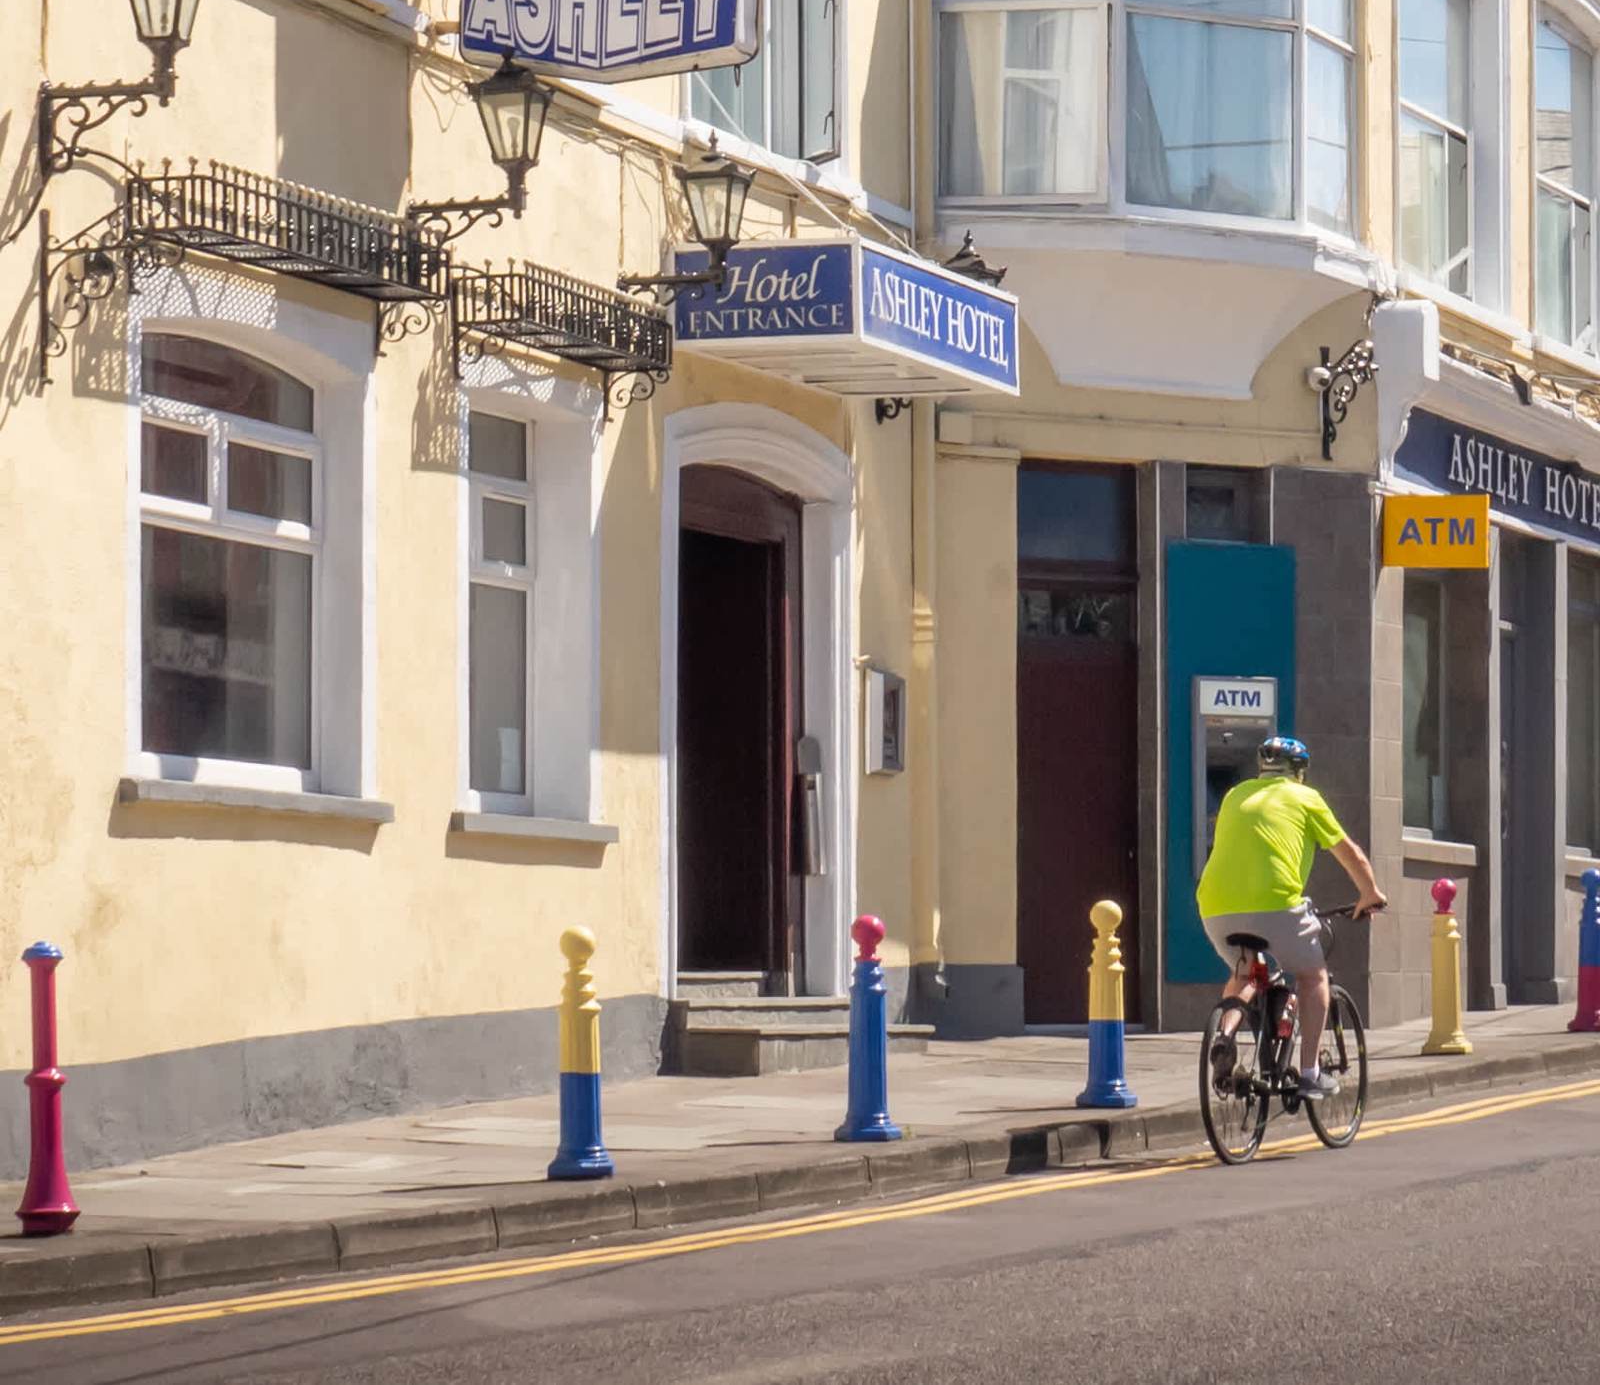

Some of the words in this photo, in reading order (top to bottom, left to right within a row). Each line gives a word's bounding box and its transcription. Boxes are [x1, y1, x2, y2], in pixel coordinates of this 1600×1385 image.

[716, 253, 828, 305] Hotel
[690, 301, 845, 335] ENTRANCE
[869, 266, 944, 342] ASHLEY
[945, 297, 1009, 368] HOTEL
[1448, 433, 1534, 506] ASHLEY
[1398, 518, 1475, 546] ATM
[1214, 688, 1262, 708] ATM
